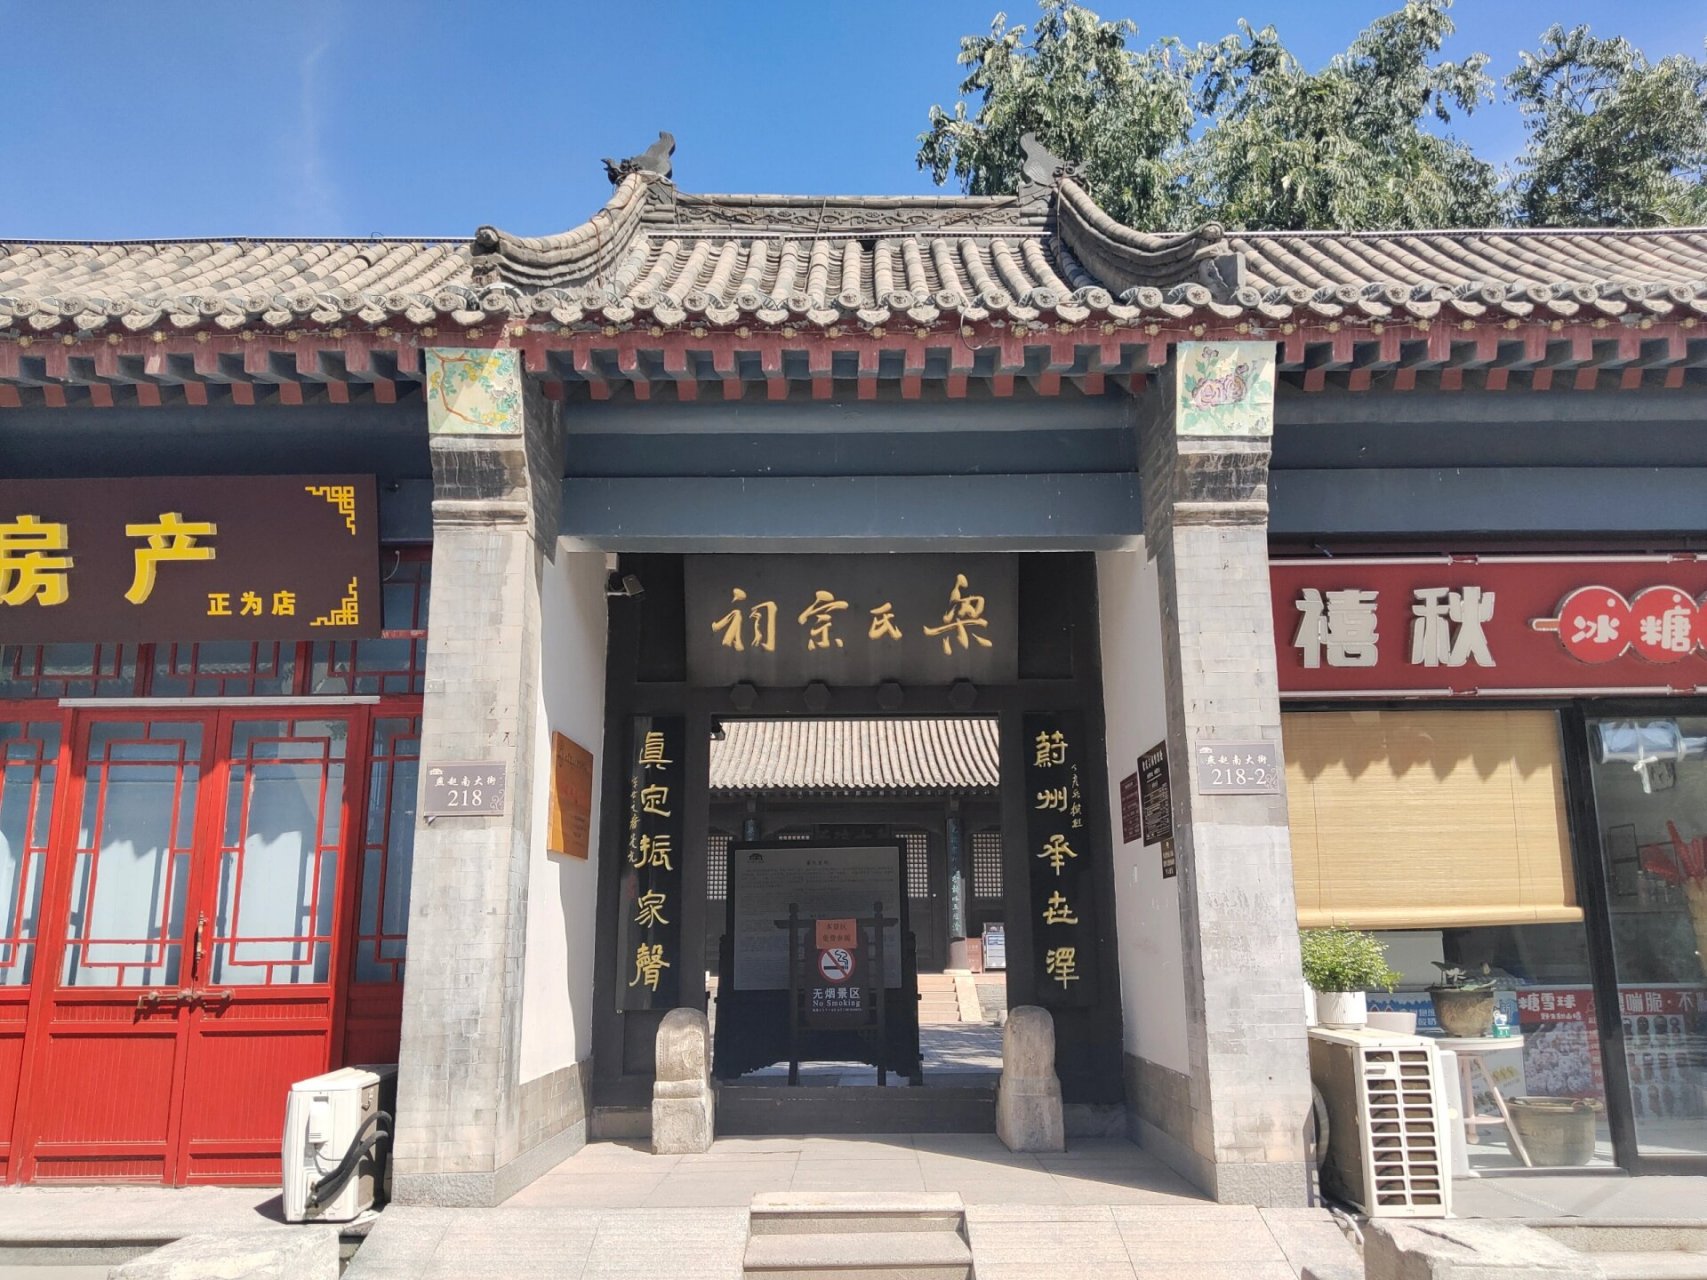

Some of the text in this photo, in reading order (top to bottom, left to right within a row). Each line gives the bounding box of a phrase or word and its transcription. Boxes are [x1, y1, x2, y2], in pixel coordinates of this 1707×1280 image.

[0, 512, 217, 606] 房产
[207, 590, 296, 616] 正为店
[1293, 586, 1497, 669] 禧秋
[1571, 605, 1692, 652] 冰糖
[1211, 768, 1267, 785] 218-2
[447, 789, 482, 807] 218
[812, 987, 861, 999] 无烟景区
[1518, 992, 1577, 1012] 糖雪球
[826, 999, 861, 1008] Smoking
